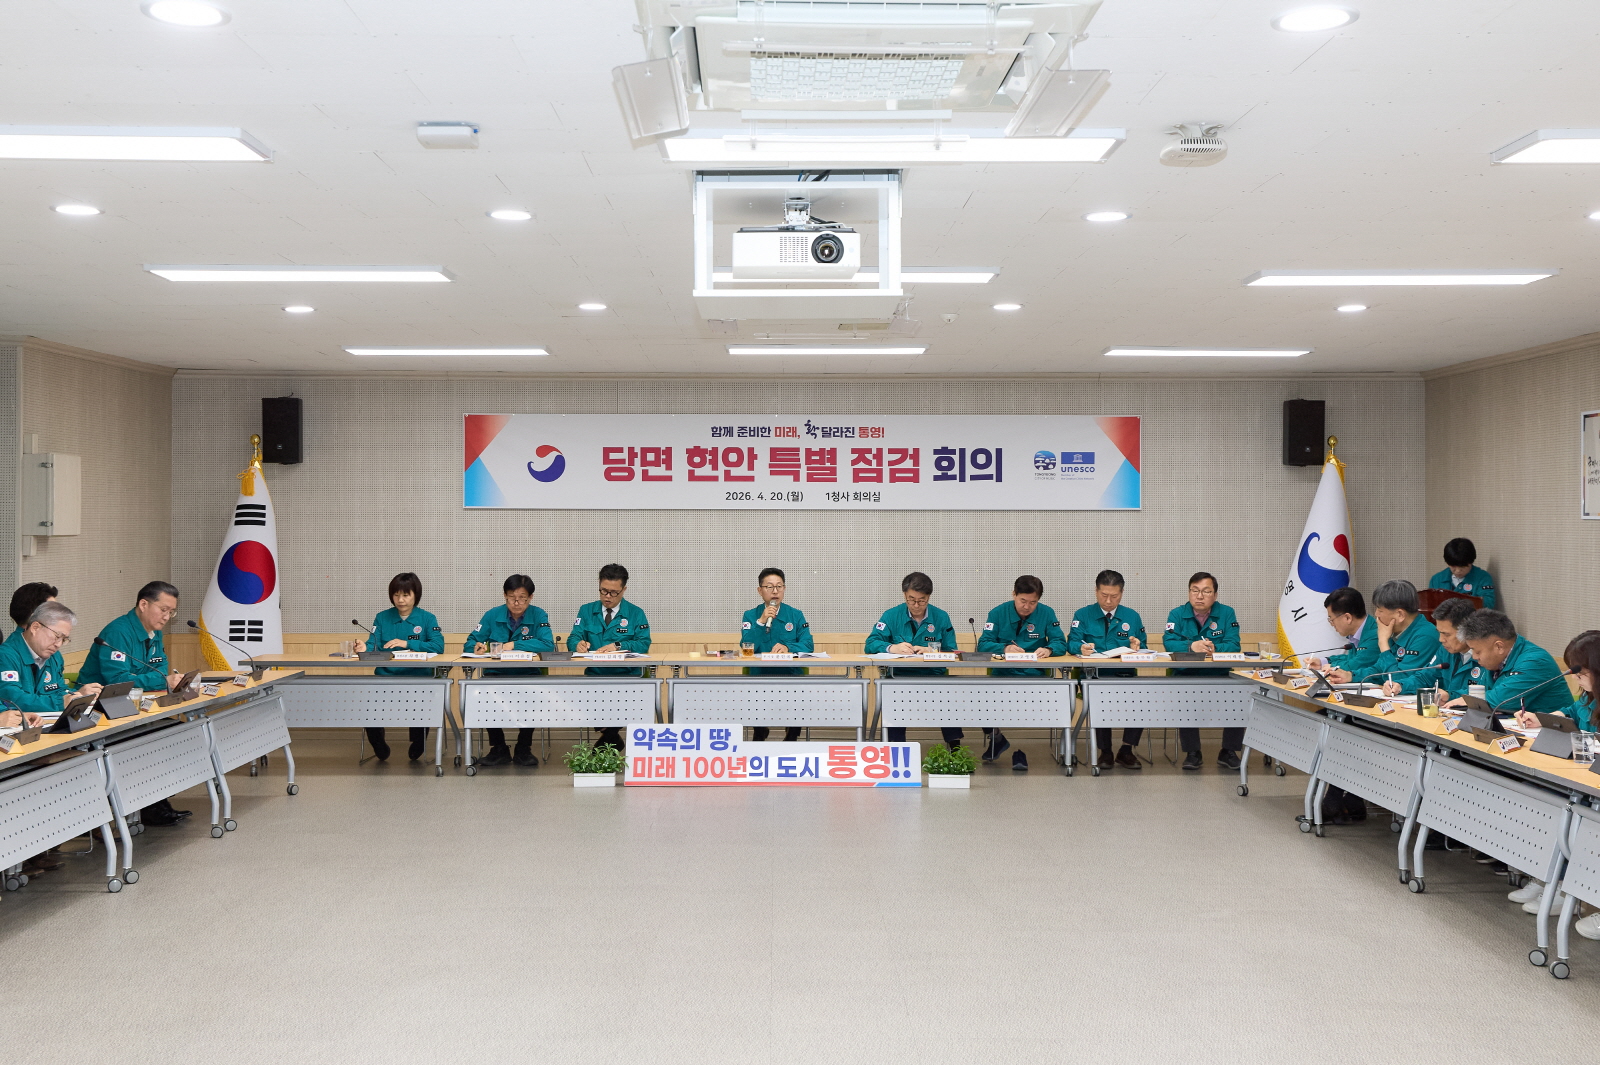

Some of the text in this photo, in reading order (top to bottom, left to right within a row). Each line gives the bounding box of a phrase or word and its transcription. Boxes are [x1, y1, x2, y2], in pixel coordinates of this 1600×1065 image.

[711, 426, 734, 438] 함께
[736, 426, 772, 438] 준비한
[774, 426, 801, 439] 미래,
[821, 426, 855, 439] 달라진
[858, 427, 885, 439] 통영!
[602, 445, 1004, 483] 당면 현안 특별 점검 회의
[725, 491, 804, 502] 2026. 4. 20.(월)
[825, 491, 881, 502] 1청사 회의실
[632, 727, 738, 753] 약속의 땅,
[632, 745, 912, 779] 미래 100년의 도시 통영!!
